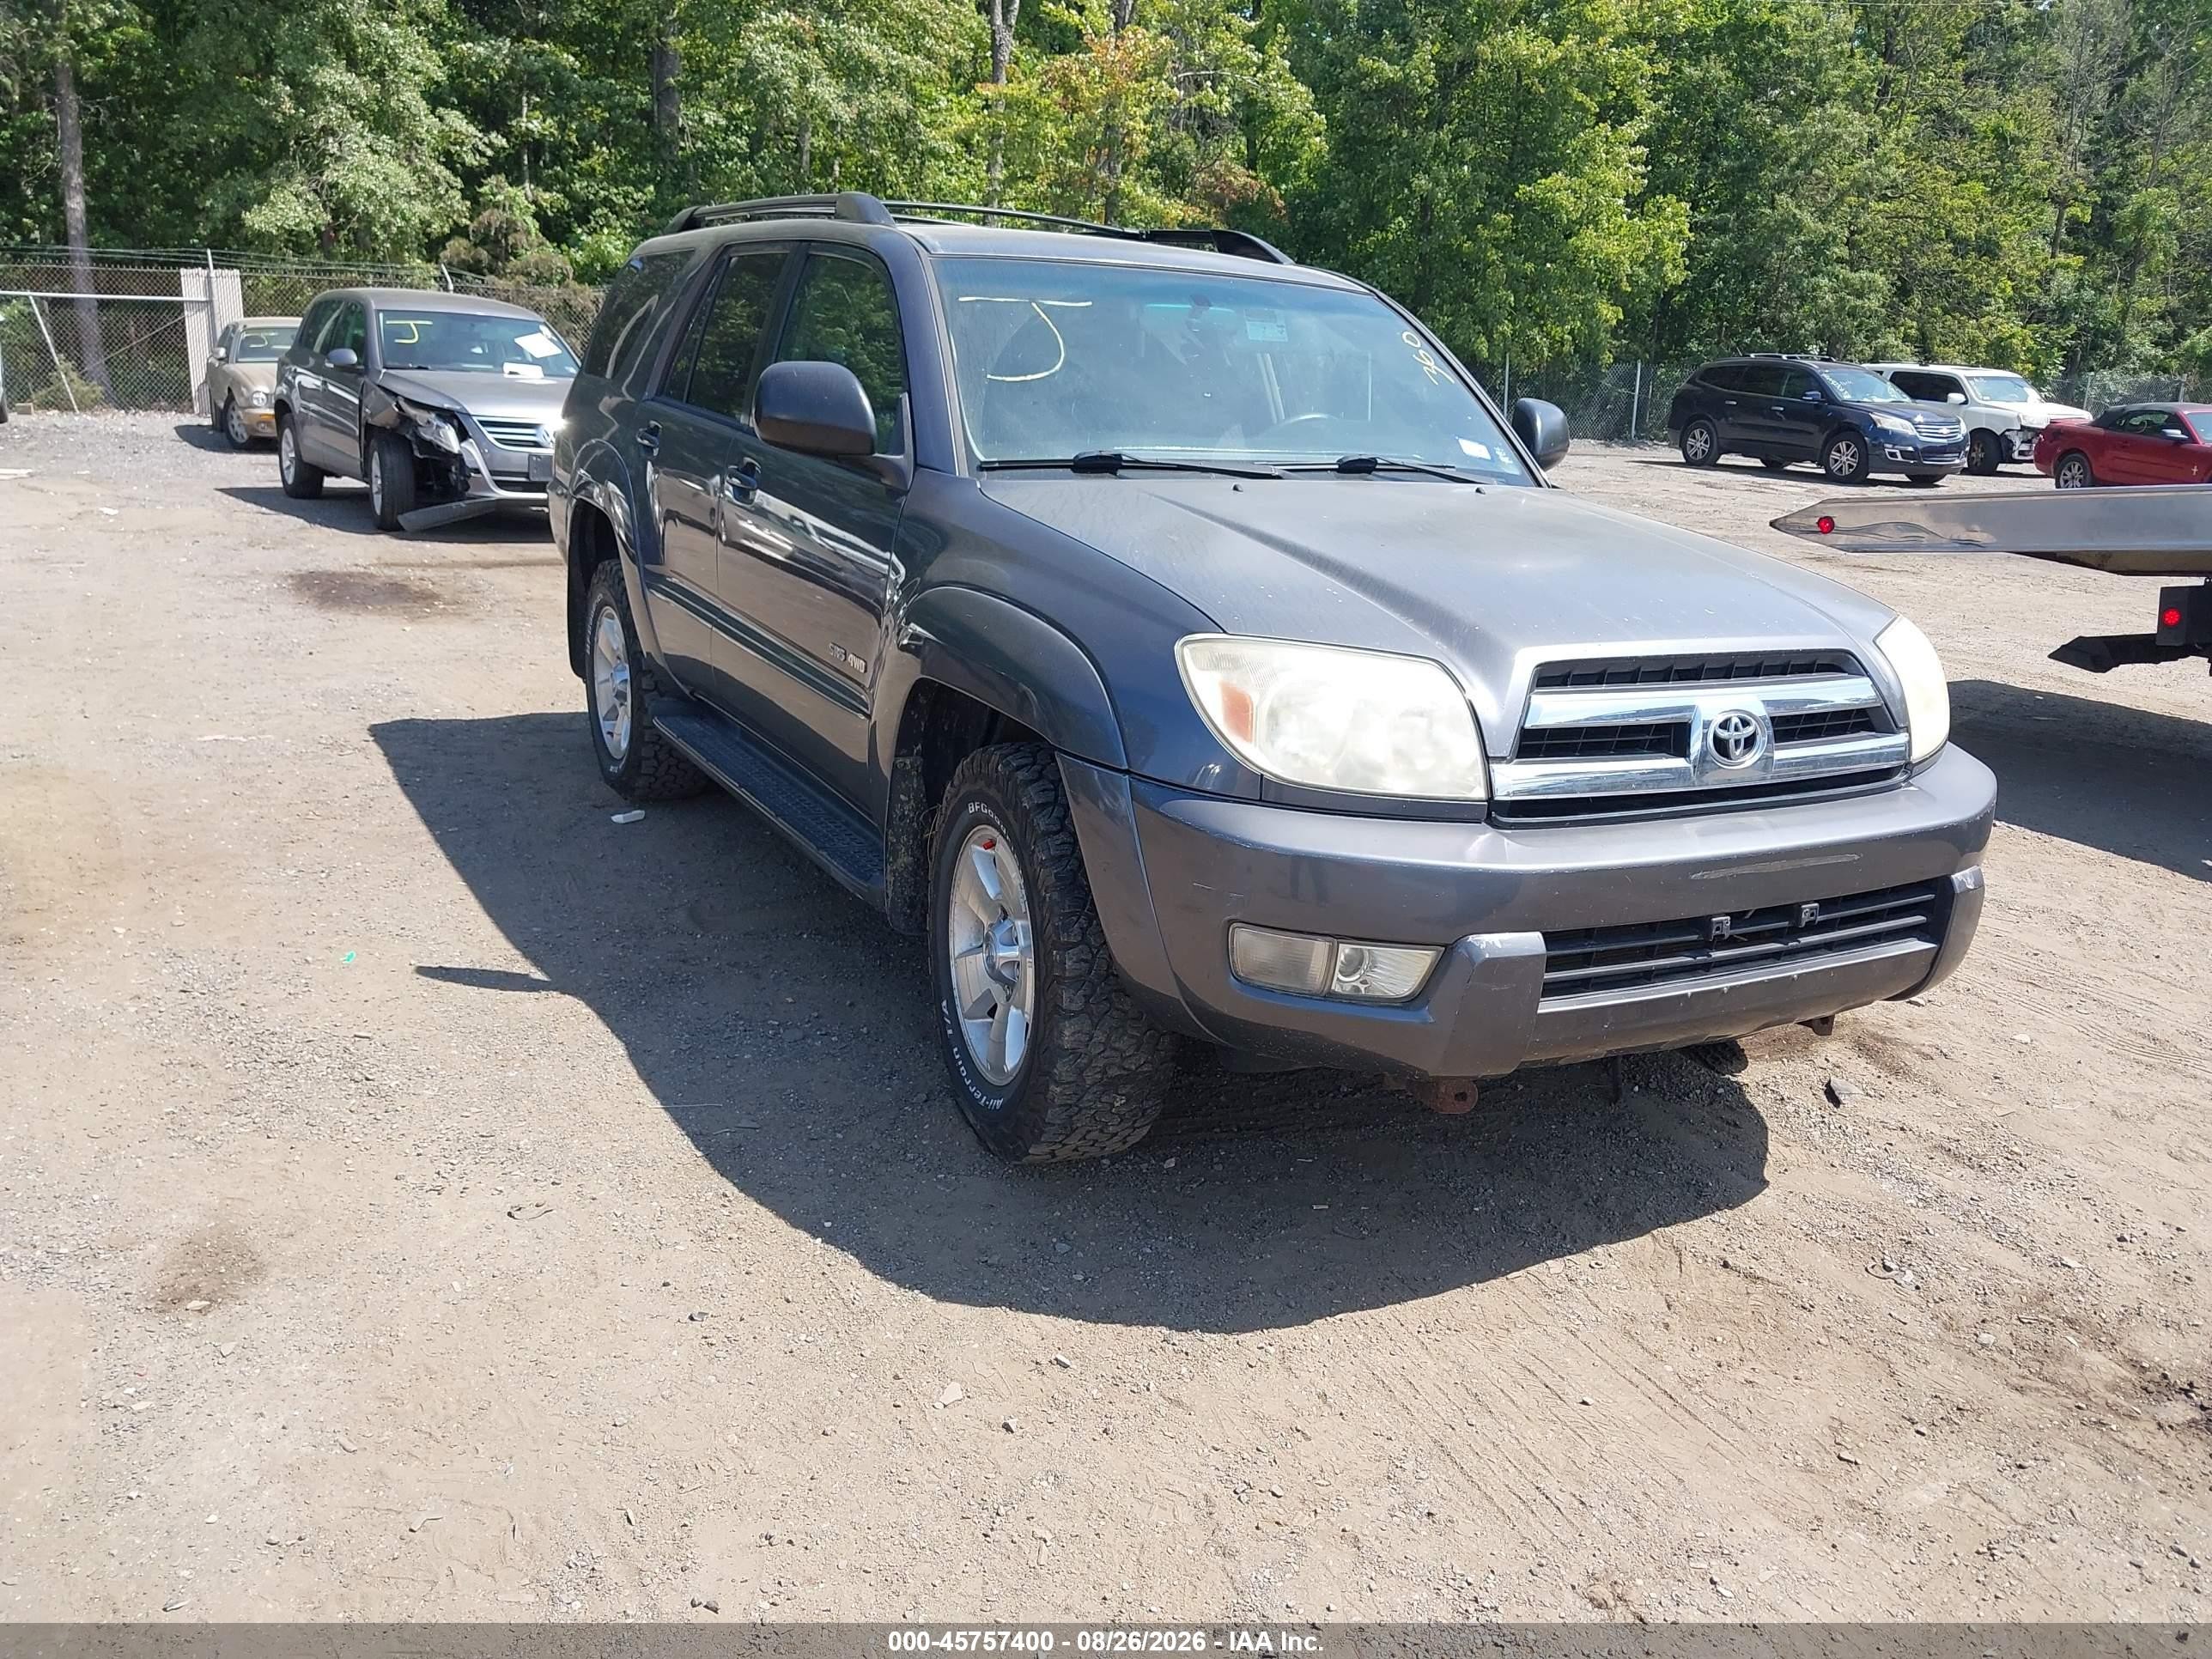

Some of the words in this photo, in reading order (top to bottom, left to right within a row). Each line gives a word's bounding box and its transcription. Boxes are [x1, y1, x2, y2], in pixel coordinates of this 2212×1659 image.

[386, 319, 434, 343] J
[958, 296, 1093, 381] J
[1401, 331, 1455, 386] 360
[848, 653, 866, 673] 4WD
[952, 1047, 1004, 1109] All-Terrain
